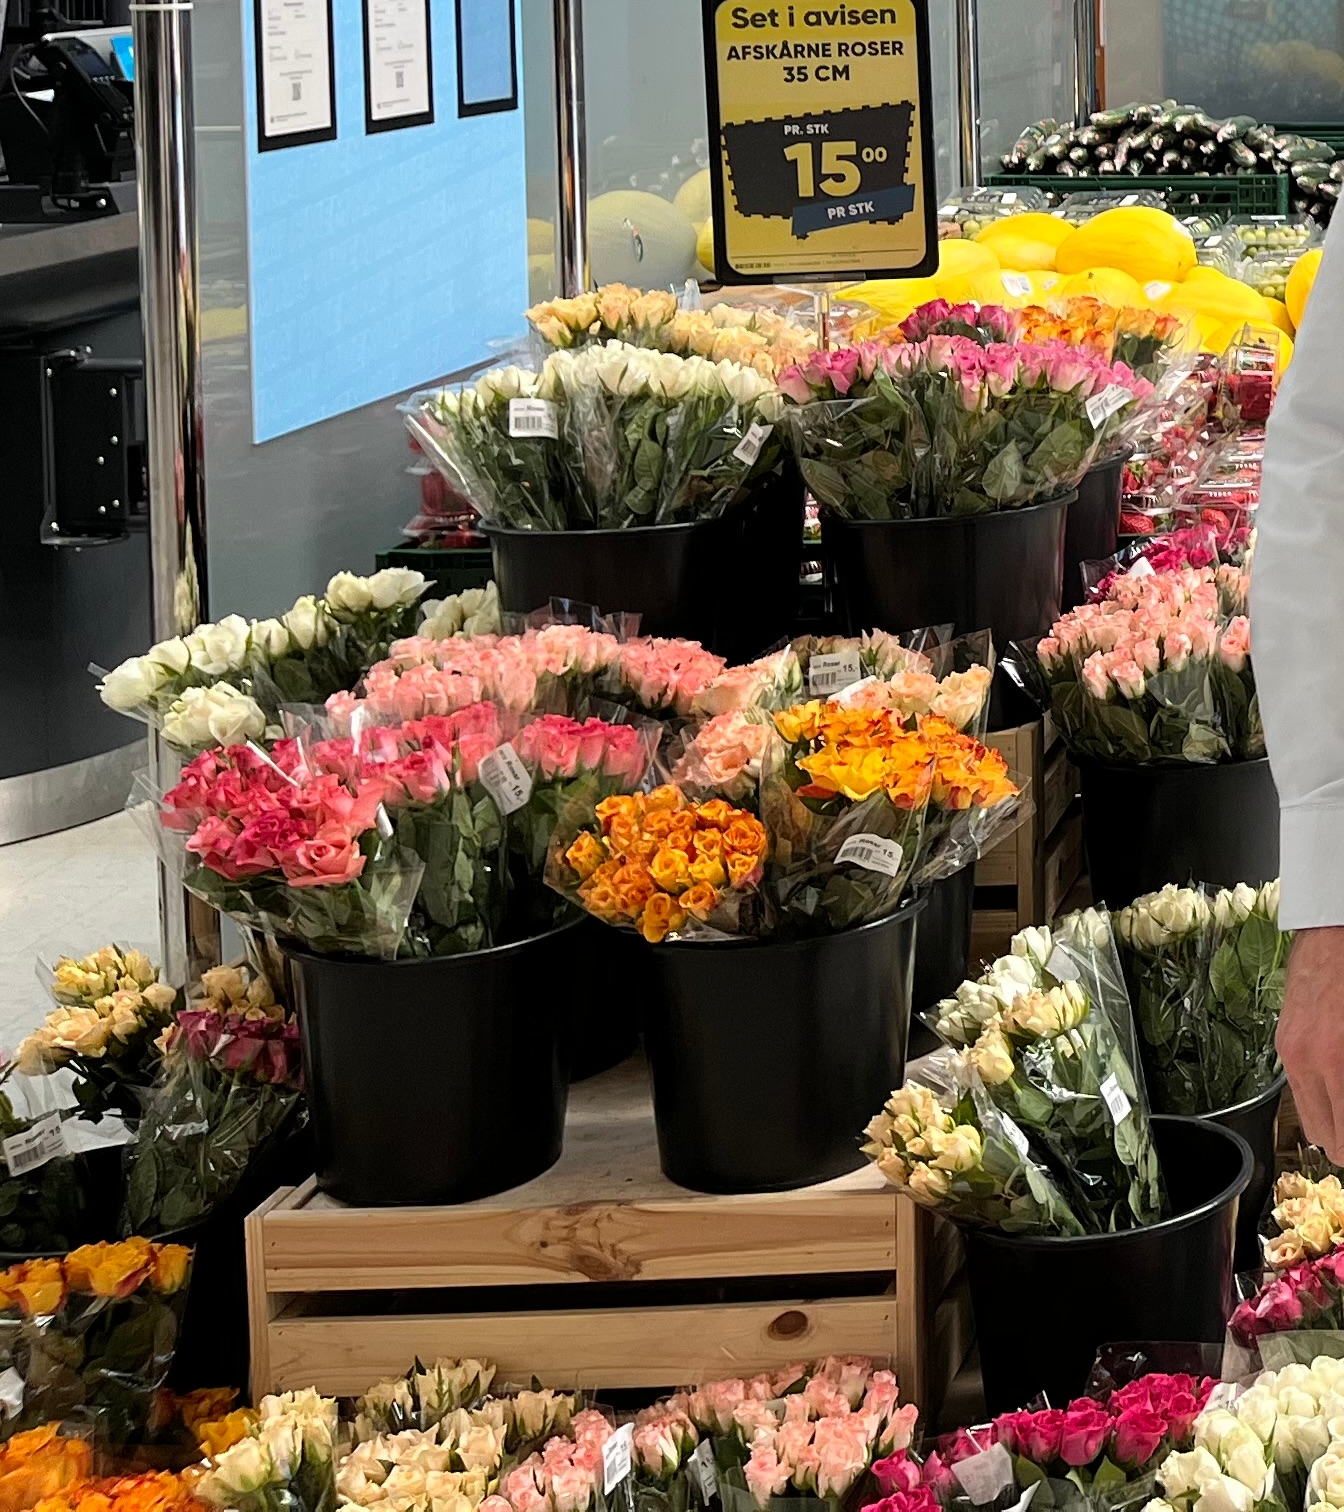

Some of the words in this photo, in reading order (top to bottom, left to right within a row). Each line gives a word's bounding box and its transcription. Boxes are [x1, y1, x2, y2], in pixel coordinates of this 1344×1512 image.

[731, 7, 779, 29] Set
[788, 5, 794, 27] i
[804, 4, 896, 27] avisen
[726, 40, 832, 61] AFSKÅRNE
[838, 40, 904, 58] ROSER
[782, 66, 808, 83] 35
[814, 64, 850, 81] CM
[784, 124, 804, 135] PR.
[806, 124, 829, 134] STK
[783, 140, 862, 198] 15
[861, 147, 888, 163] 00
[827, 206, 846, 220] PR
[849, 201, 875, 216] STK
